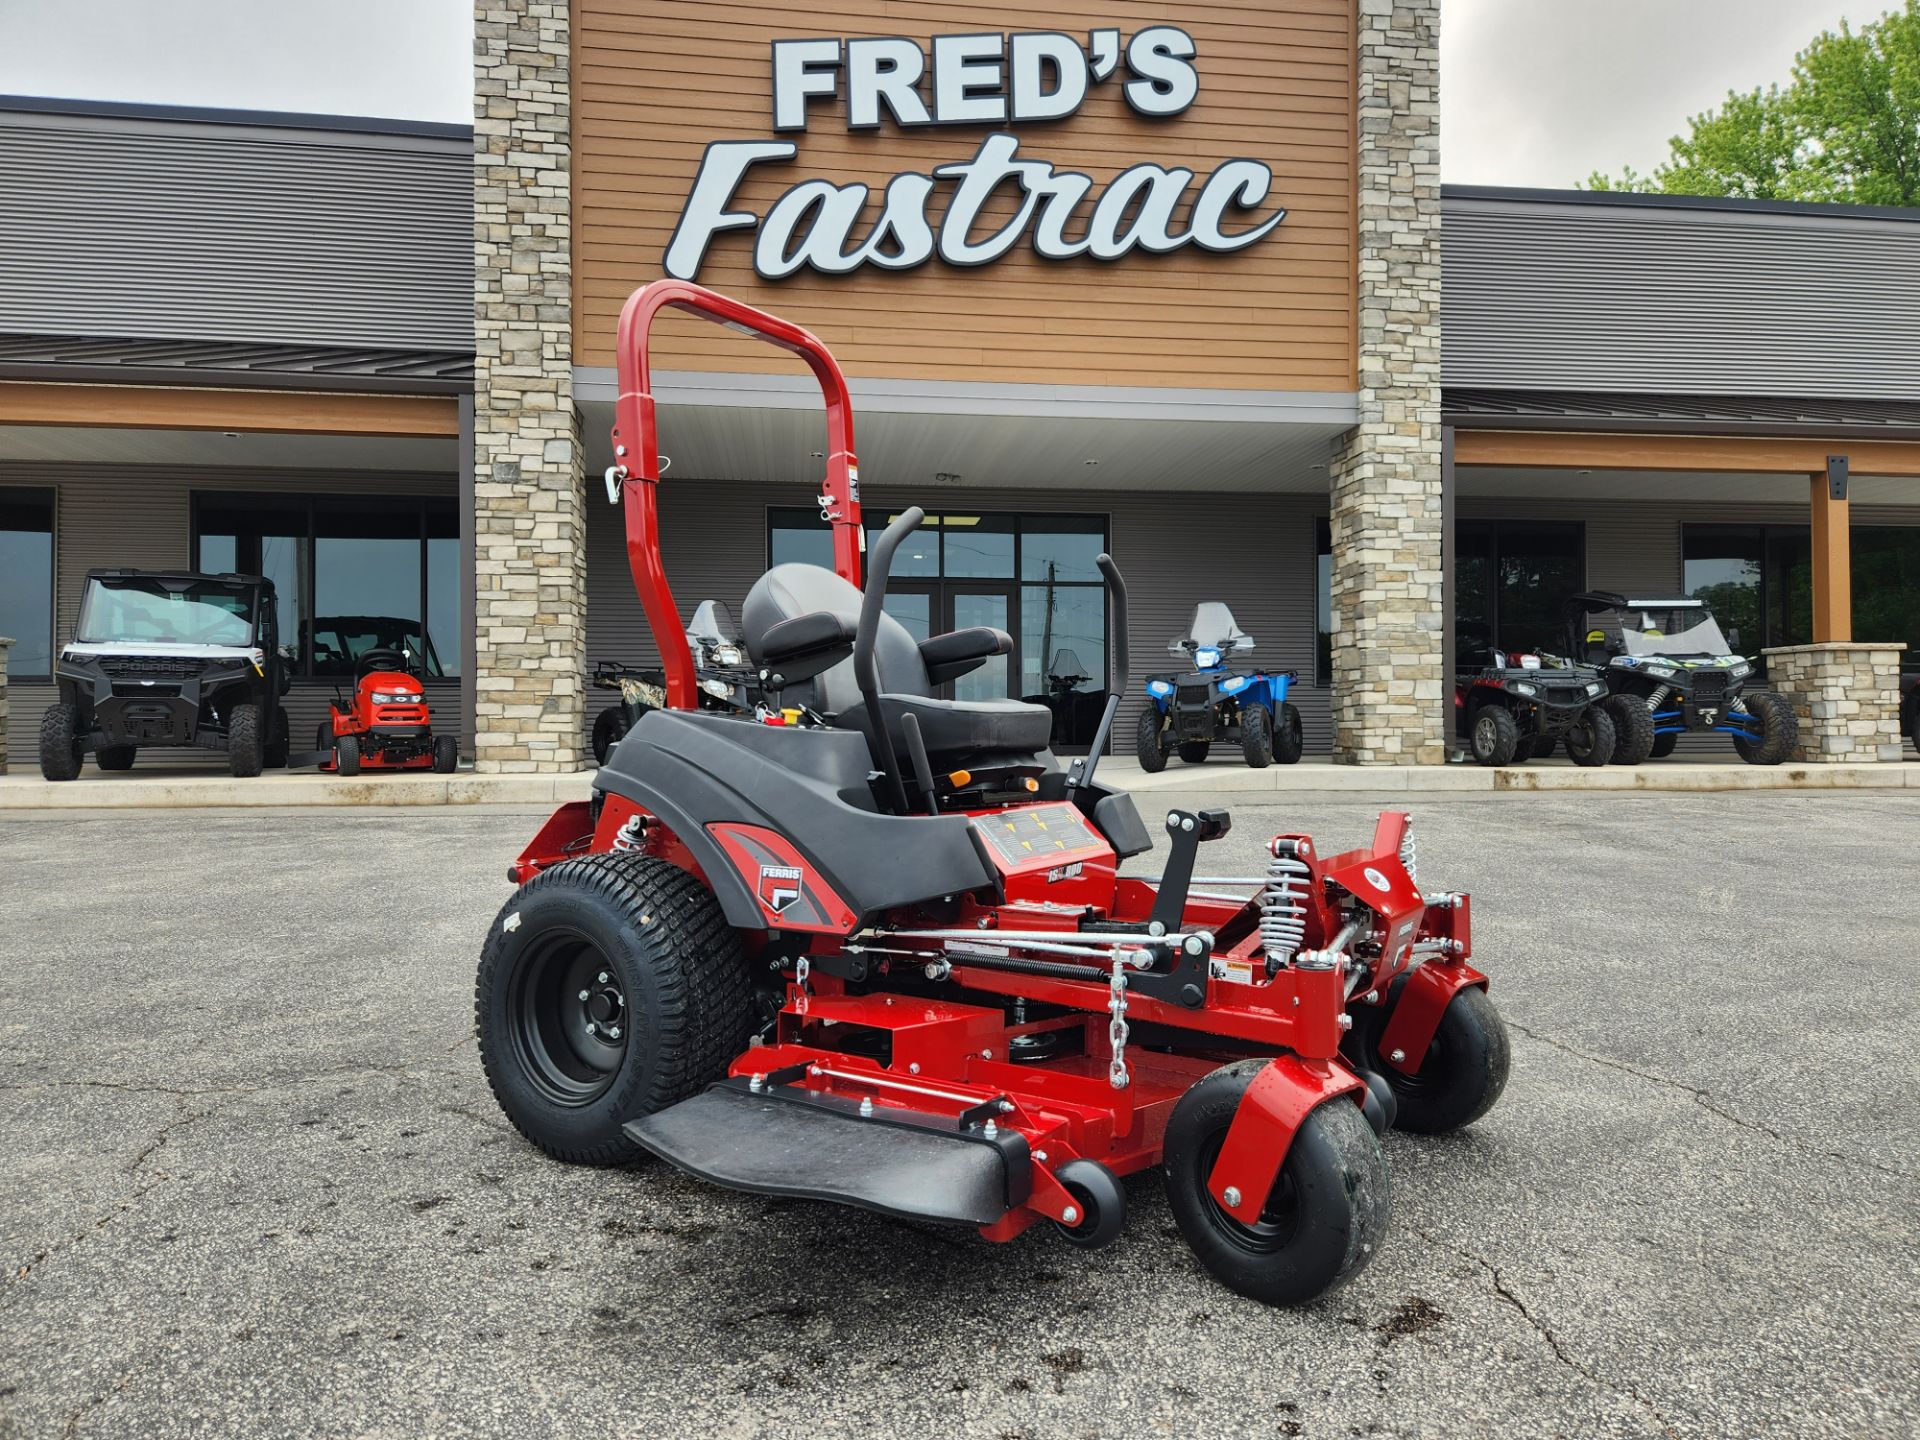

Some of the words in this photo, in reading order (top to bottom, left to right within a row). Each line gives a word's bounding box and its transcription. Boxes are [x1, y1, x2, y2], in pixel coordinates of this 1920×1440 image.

[771, 25, 1199, 132] FRED'S
[662, 132, 1288, 281] Fastrac
[118, 662, 186, 672] POLARIS
[762, 867, 800, 880] FERRIS
